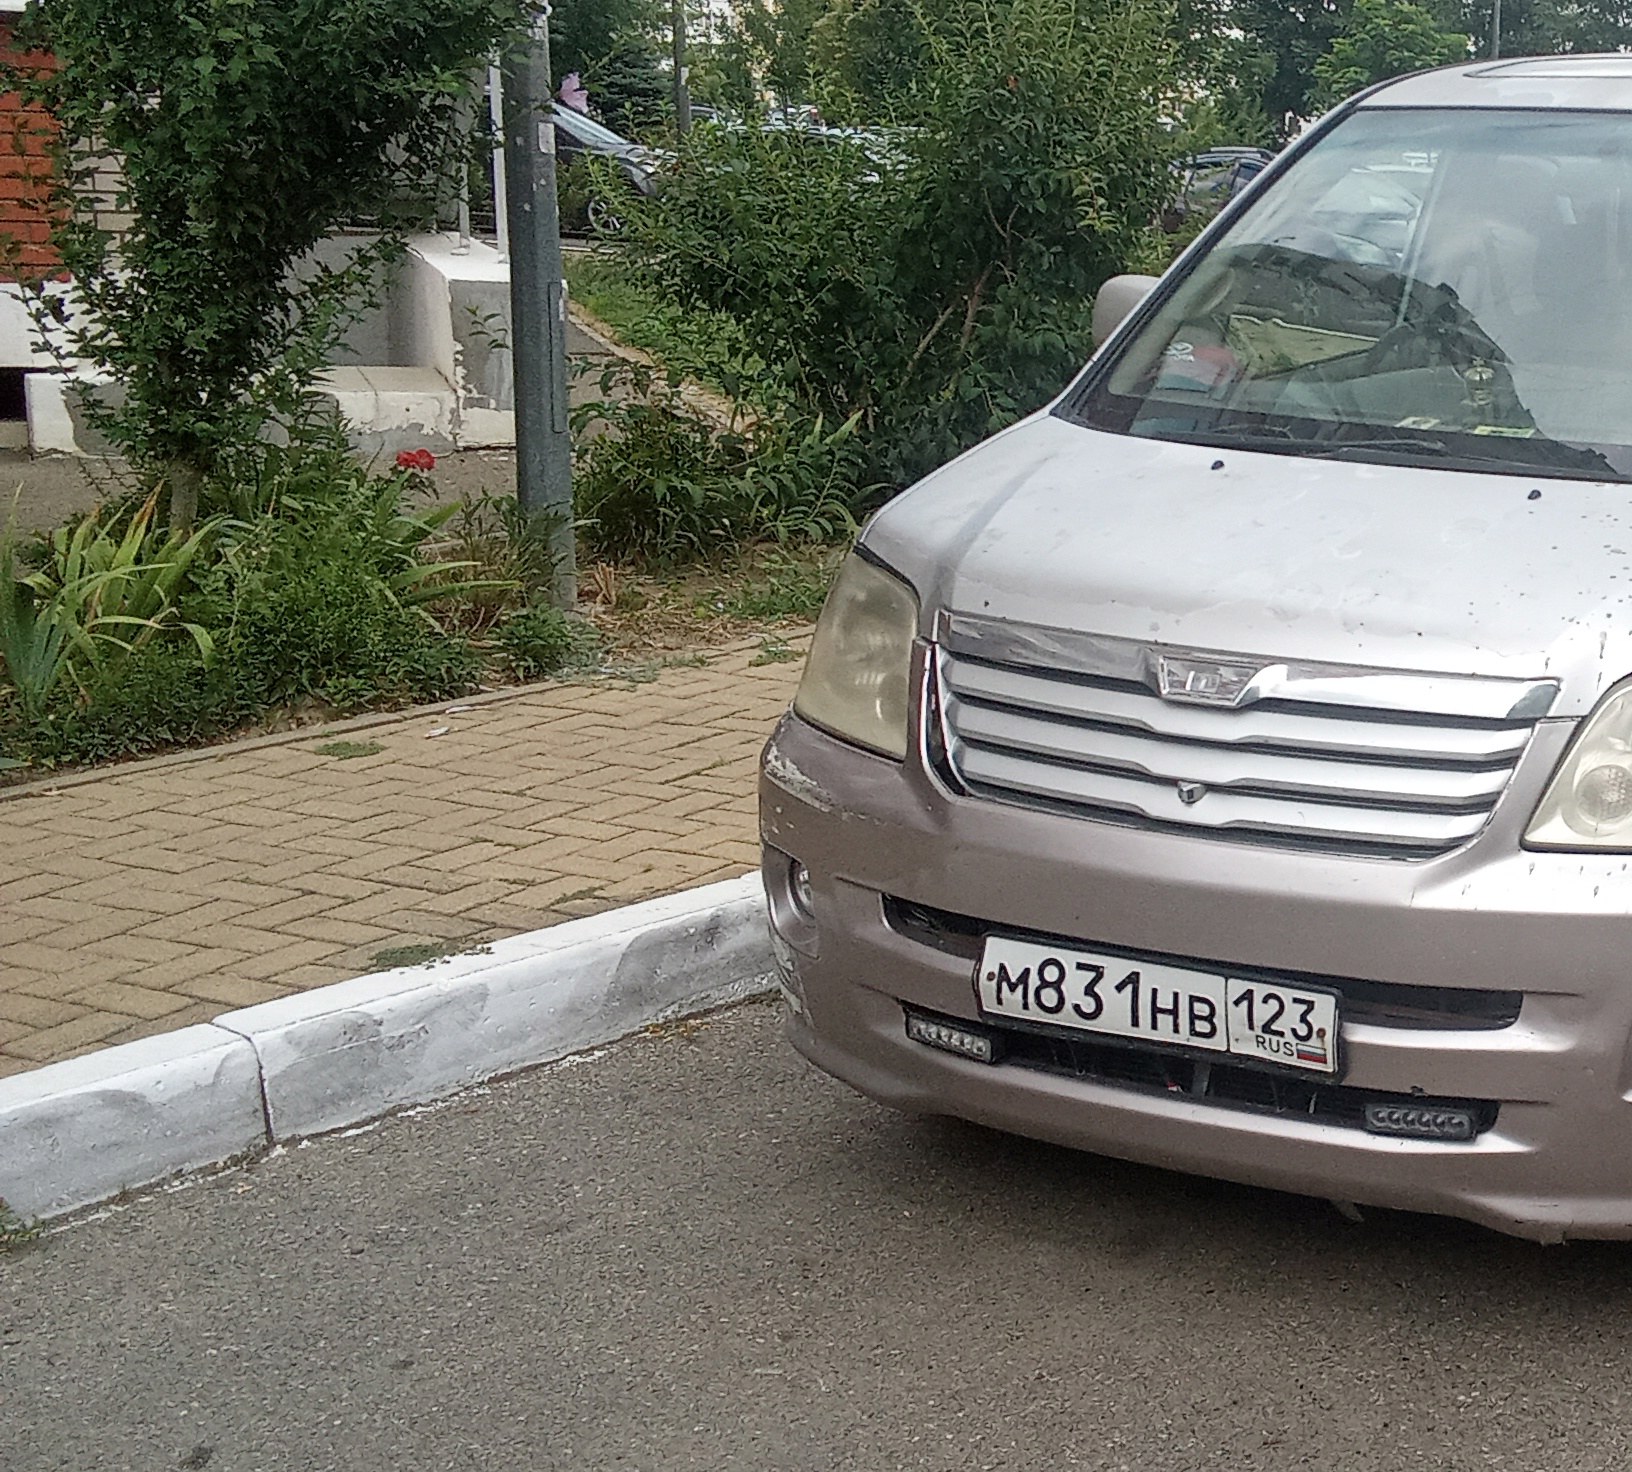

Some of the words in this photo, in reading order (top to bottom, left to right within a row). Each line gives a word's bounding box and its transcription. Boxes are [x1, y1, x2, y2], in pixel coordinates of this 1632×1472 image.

[995, 957, 1217, 1039] М831НВ
[1233, 988, 1315, 1042] 123
[1256, 1035, 1295, 1057] RUS
